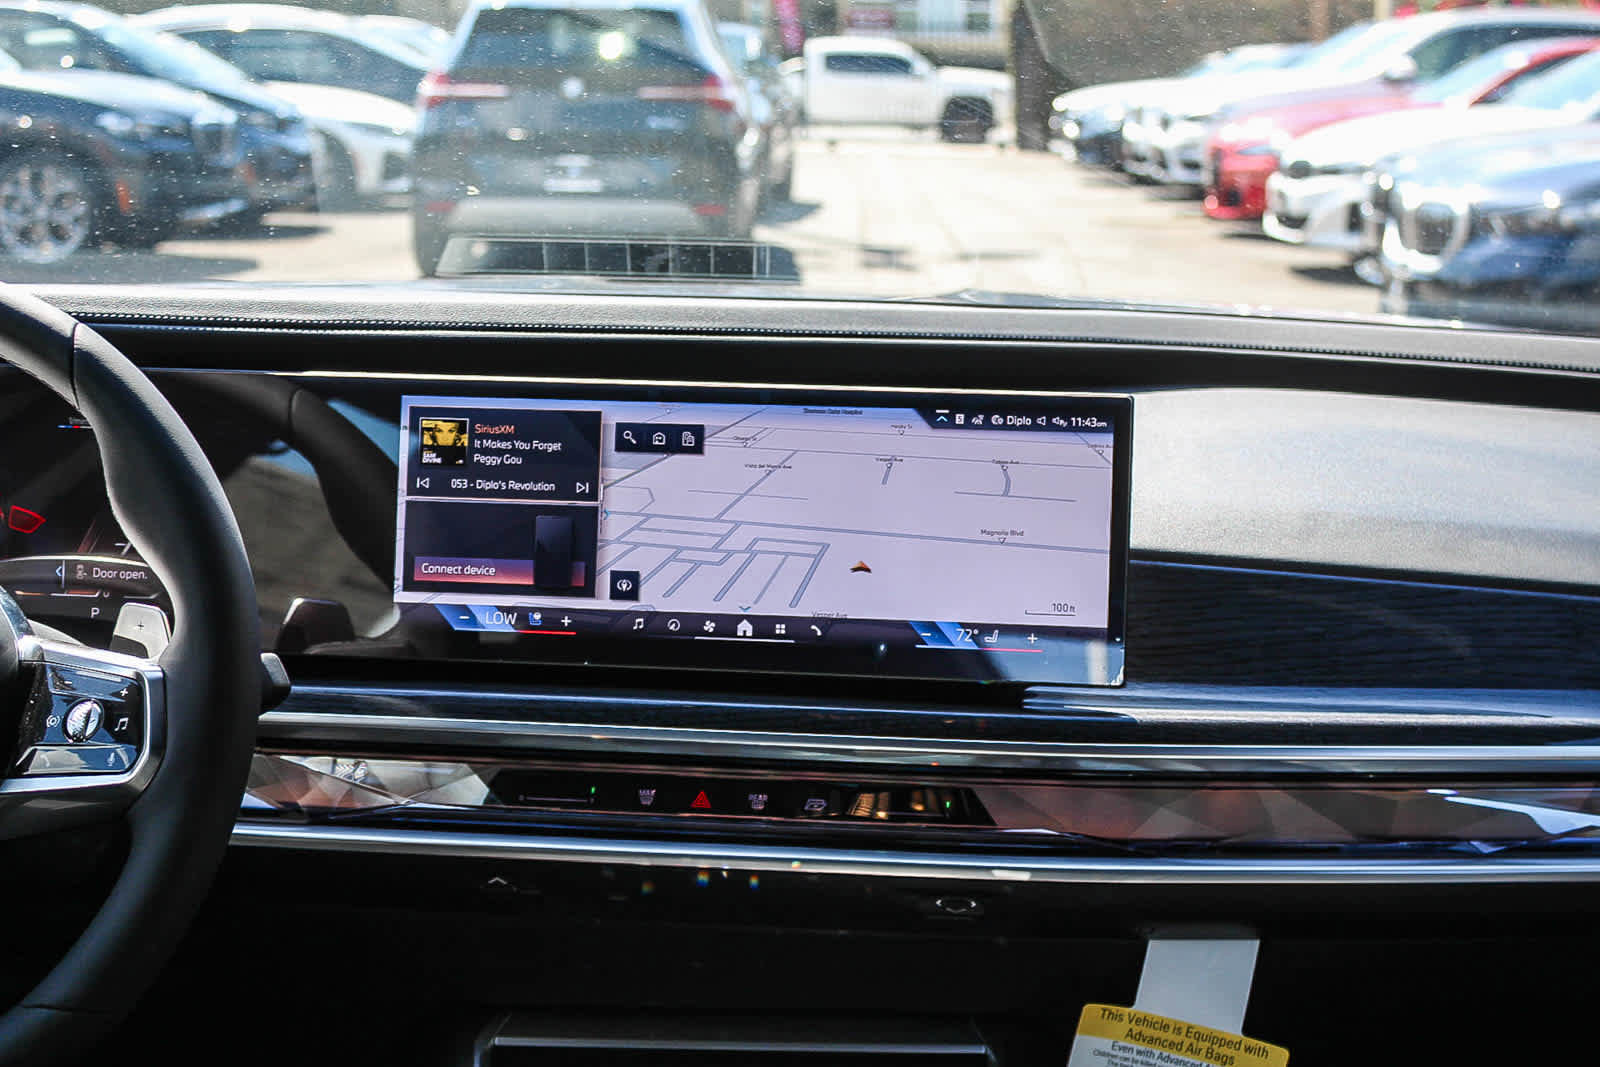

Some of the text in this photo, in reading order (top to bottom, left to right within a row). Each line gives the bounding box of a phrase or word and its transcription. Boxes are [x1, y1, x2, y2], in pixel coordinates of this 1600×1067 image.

[1006, 415, 1032, 427] Diplo
[1070, 417, 1108, 428] 11:43am
[474, 424, 515, 434] SiriusXM
[474, 440, 562, 452] It Makes You Forget
[474, 454, 522, 465] Peggy Gou
[451, 478, 468, 488] 053
[476, 479, 507, 491] Diplo's
[508, 480, 555, 491] Revolution
[980, 529, 1025, 537] Magnolia Blvd
[92, 567, 148, 581] Door open.
[421, 562, 496, 576] Connect device
[90, 608, 100, 618] P
[1052, 602, 1076, 613] 100 ft
[485, 611, 517, 625] LOW
[955, 628, 980, 642] 72°
[1099, 1007, 1269, 1059] This Vehicle is Equipped with
[1111, 1041, 1134, 1055] Even
[1135, 1046, 1156, 1059] with
[1124, 1027, 1235, 1067] Advanced Air Bags
